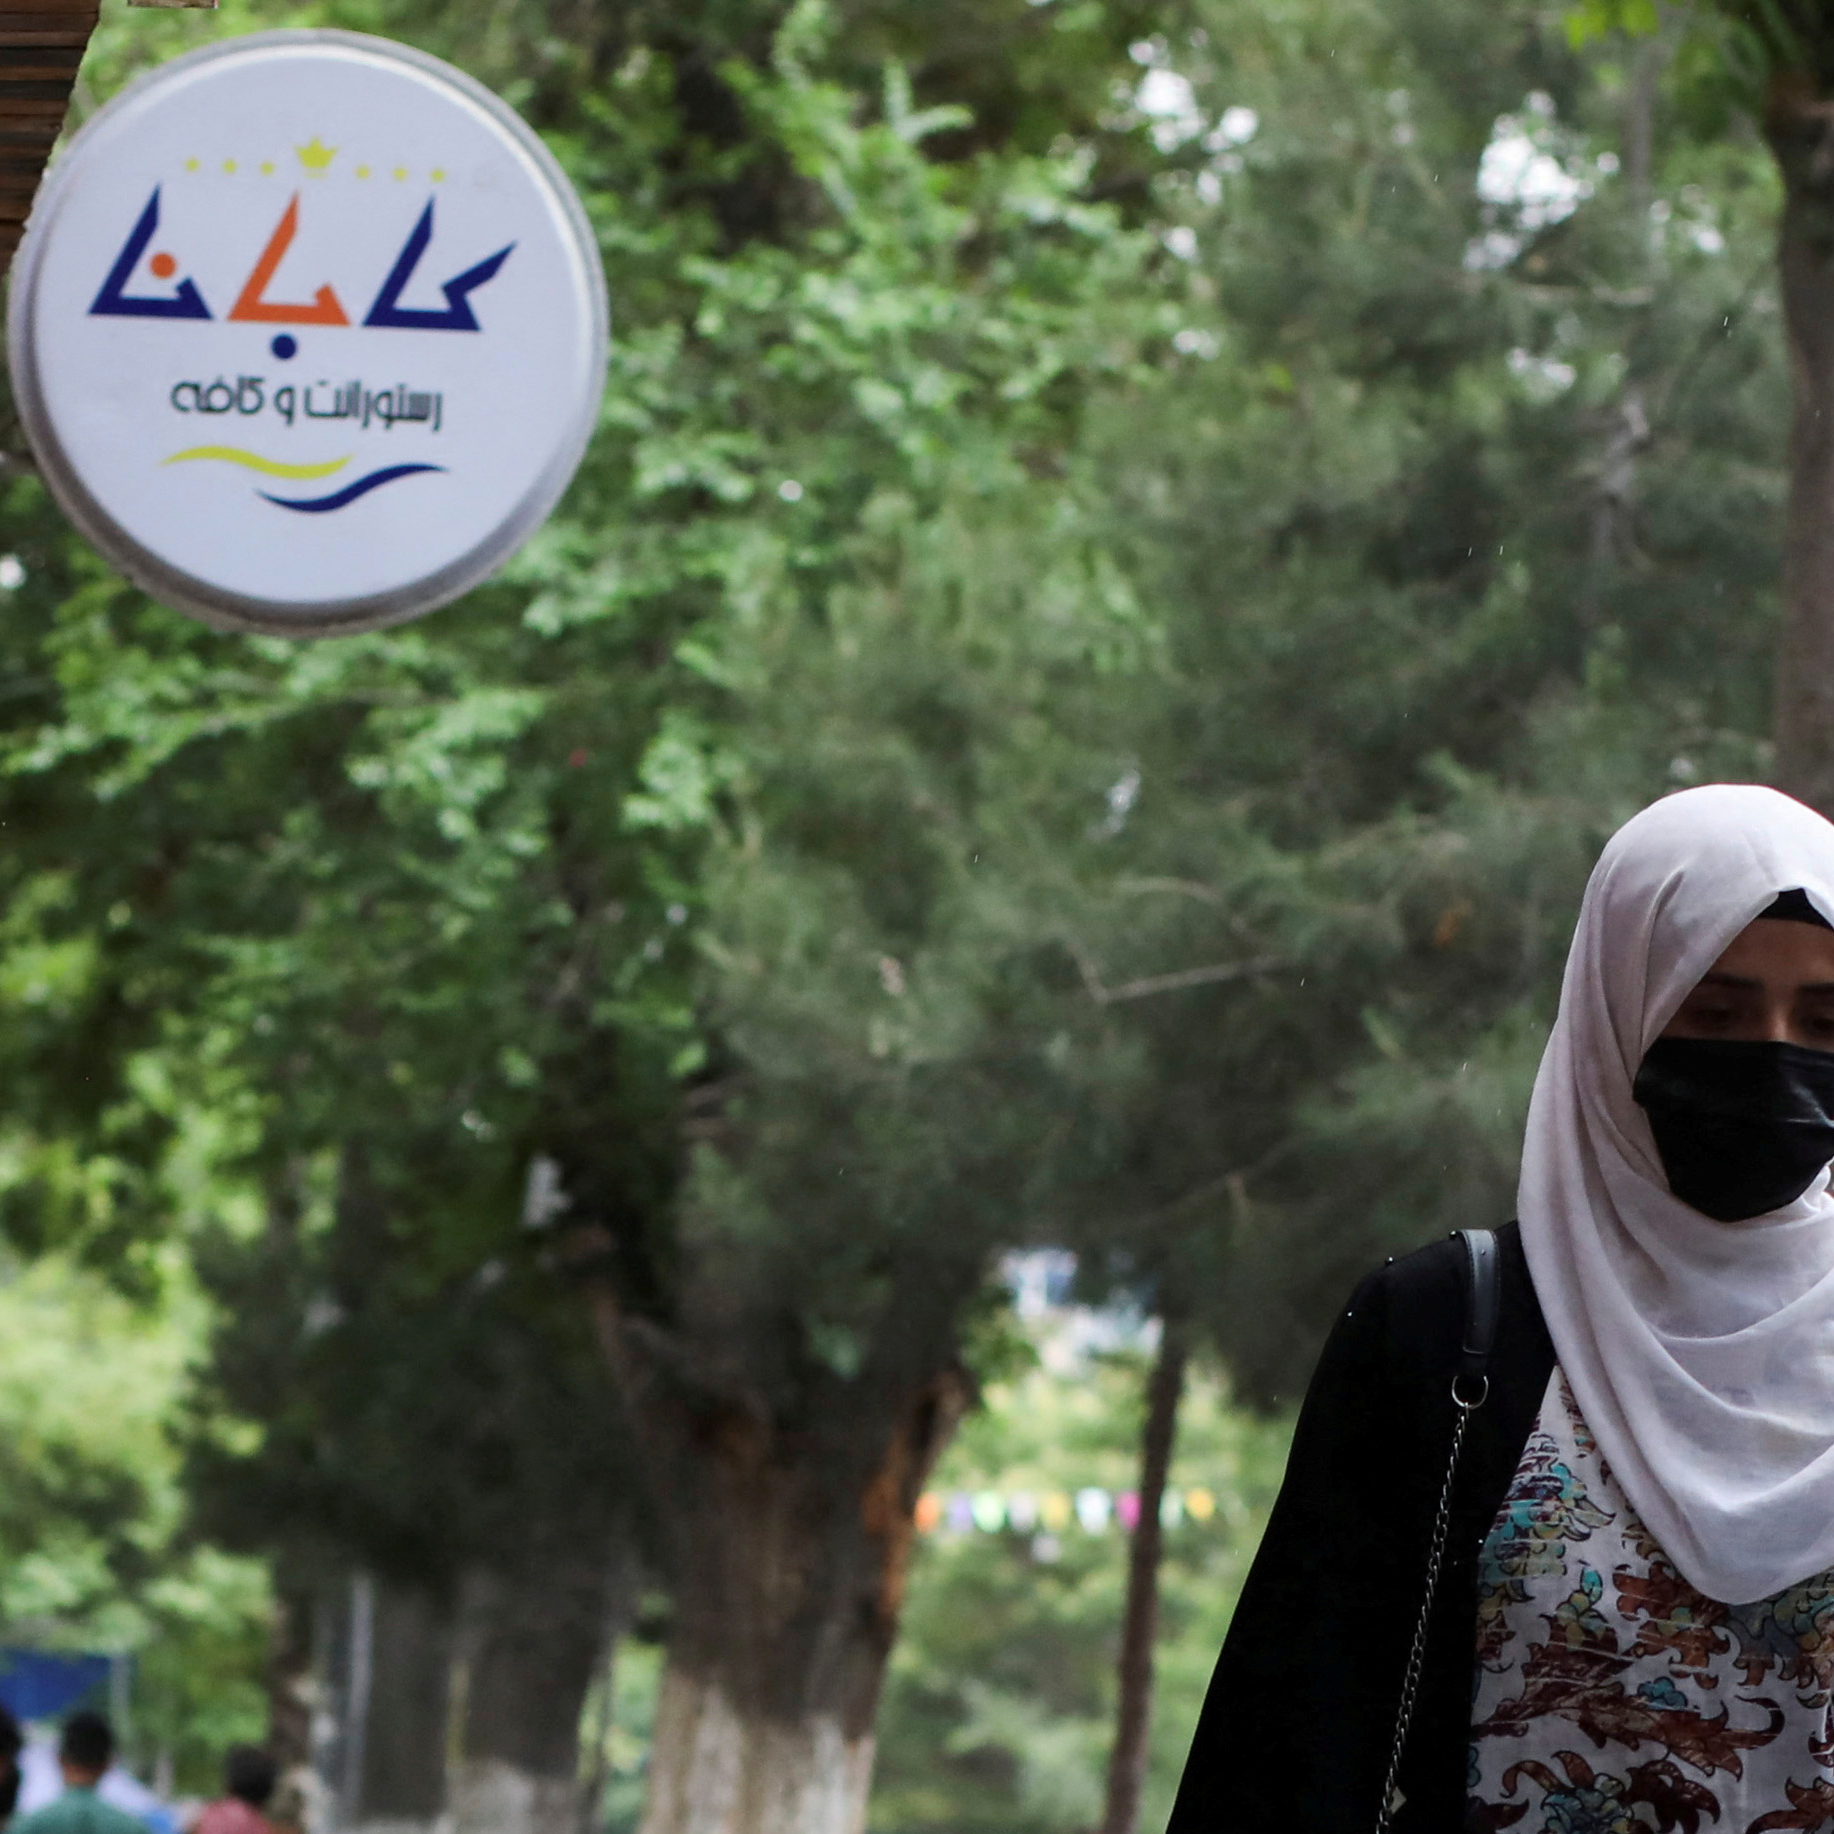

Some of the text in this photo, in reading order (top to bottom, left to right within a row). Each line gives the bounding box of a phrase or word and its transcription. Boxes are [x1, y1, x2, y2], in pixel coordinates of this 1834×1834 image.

[170, 374, 443, 432] رستورانت و کافه
